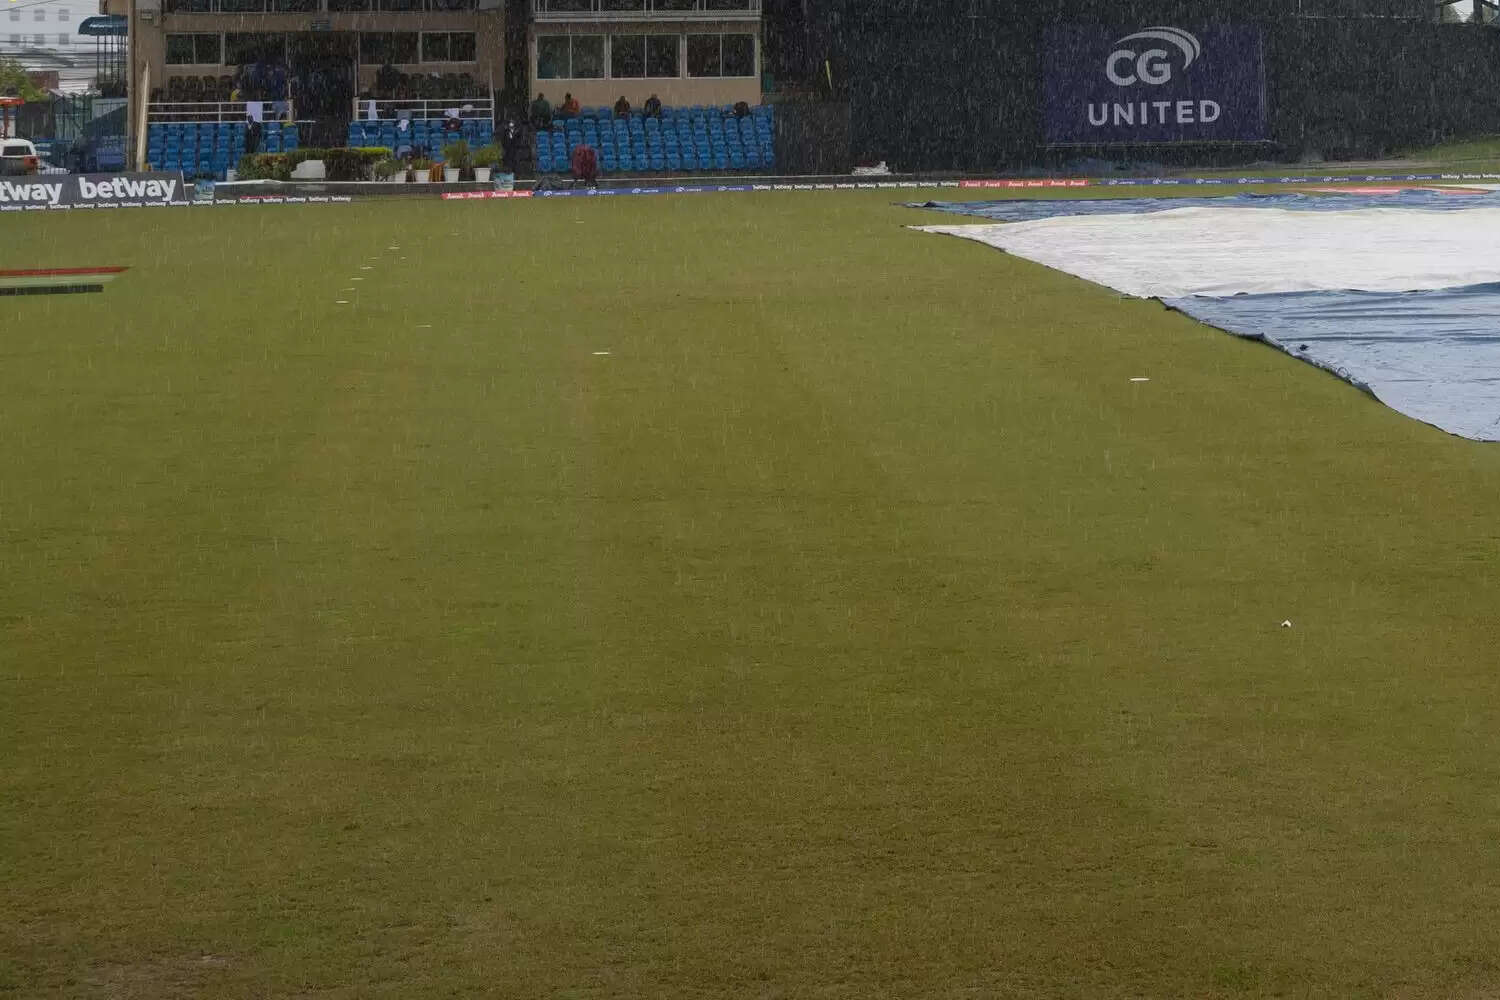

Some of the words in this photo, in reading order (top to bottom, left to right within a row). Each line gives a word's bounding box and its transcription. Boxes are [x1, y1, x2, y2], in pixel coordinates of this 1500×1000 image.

[1106, 49, 1172, 87] CG
[1088, 100, 1221, 126] UNITED
[78, 176, 177, 201] betway
